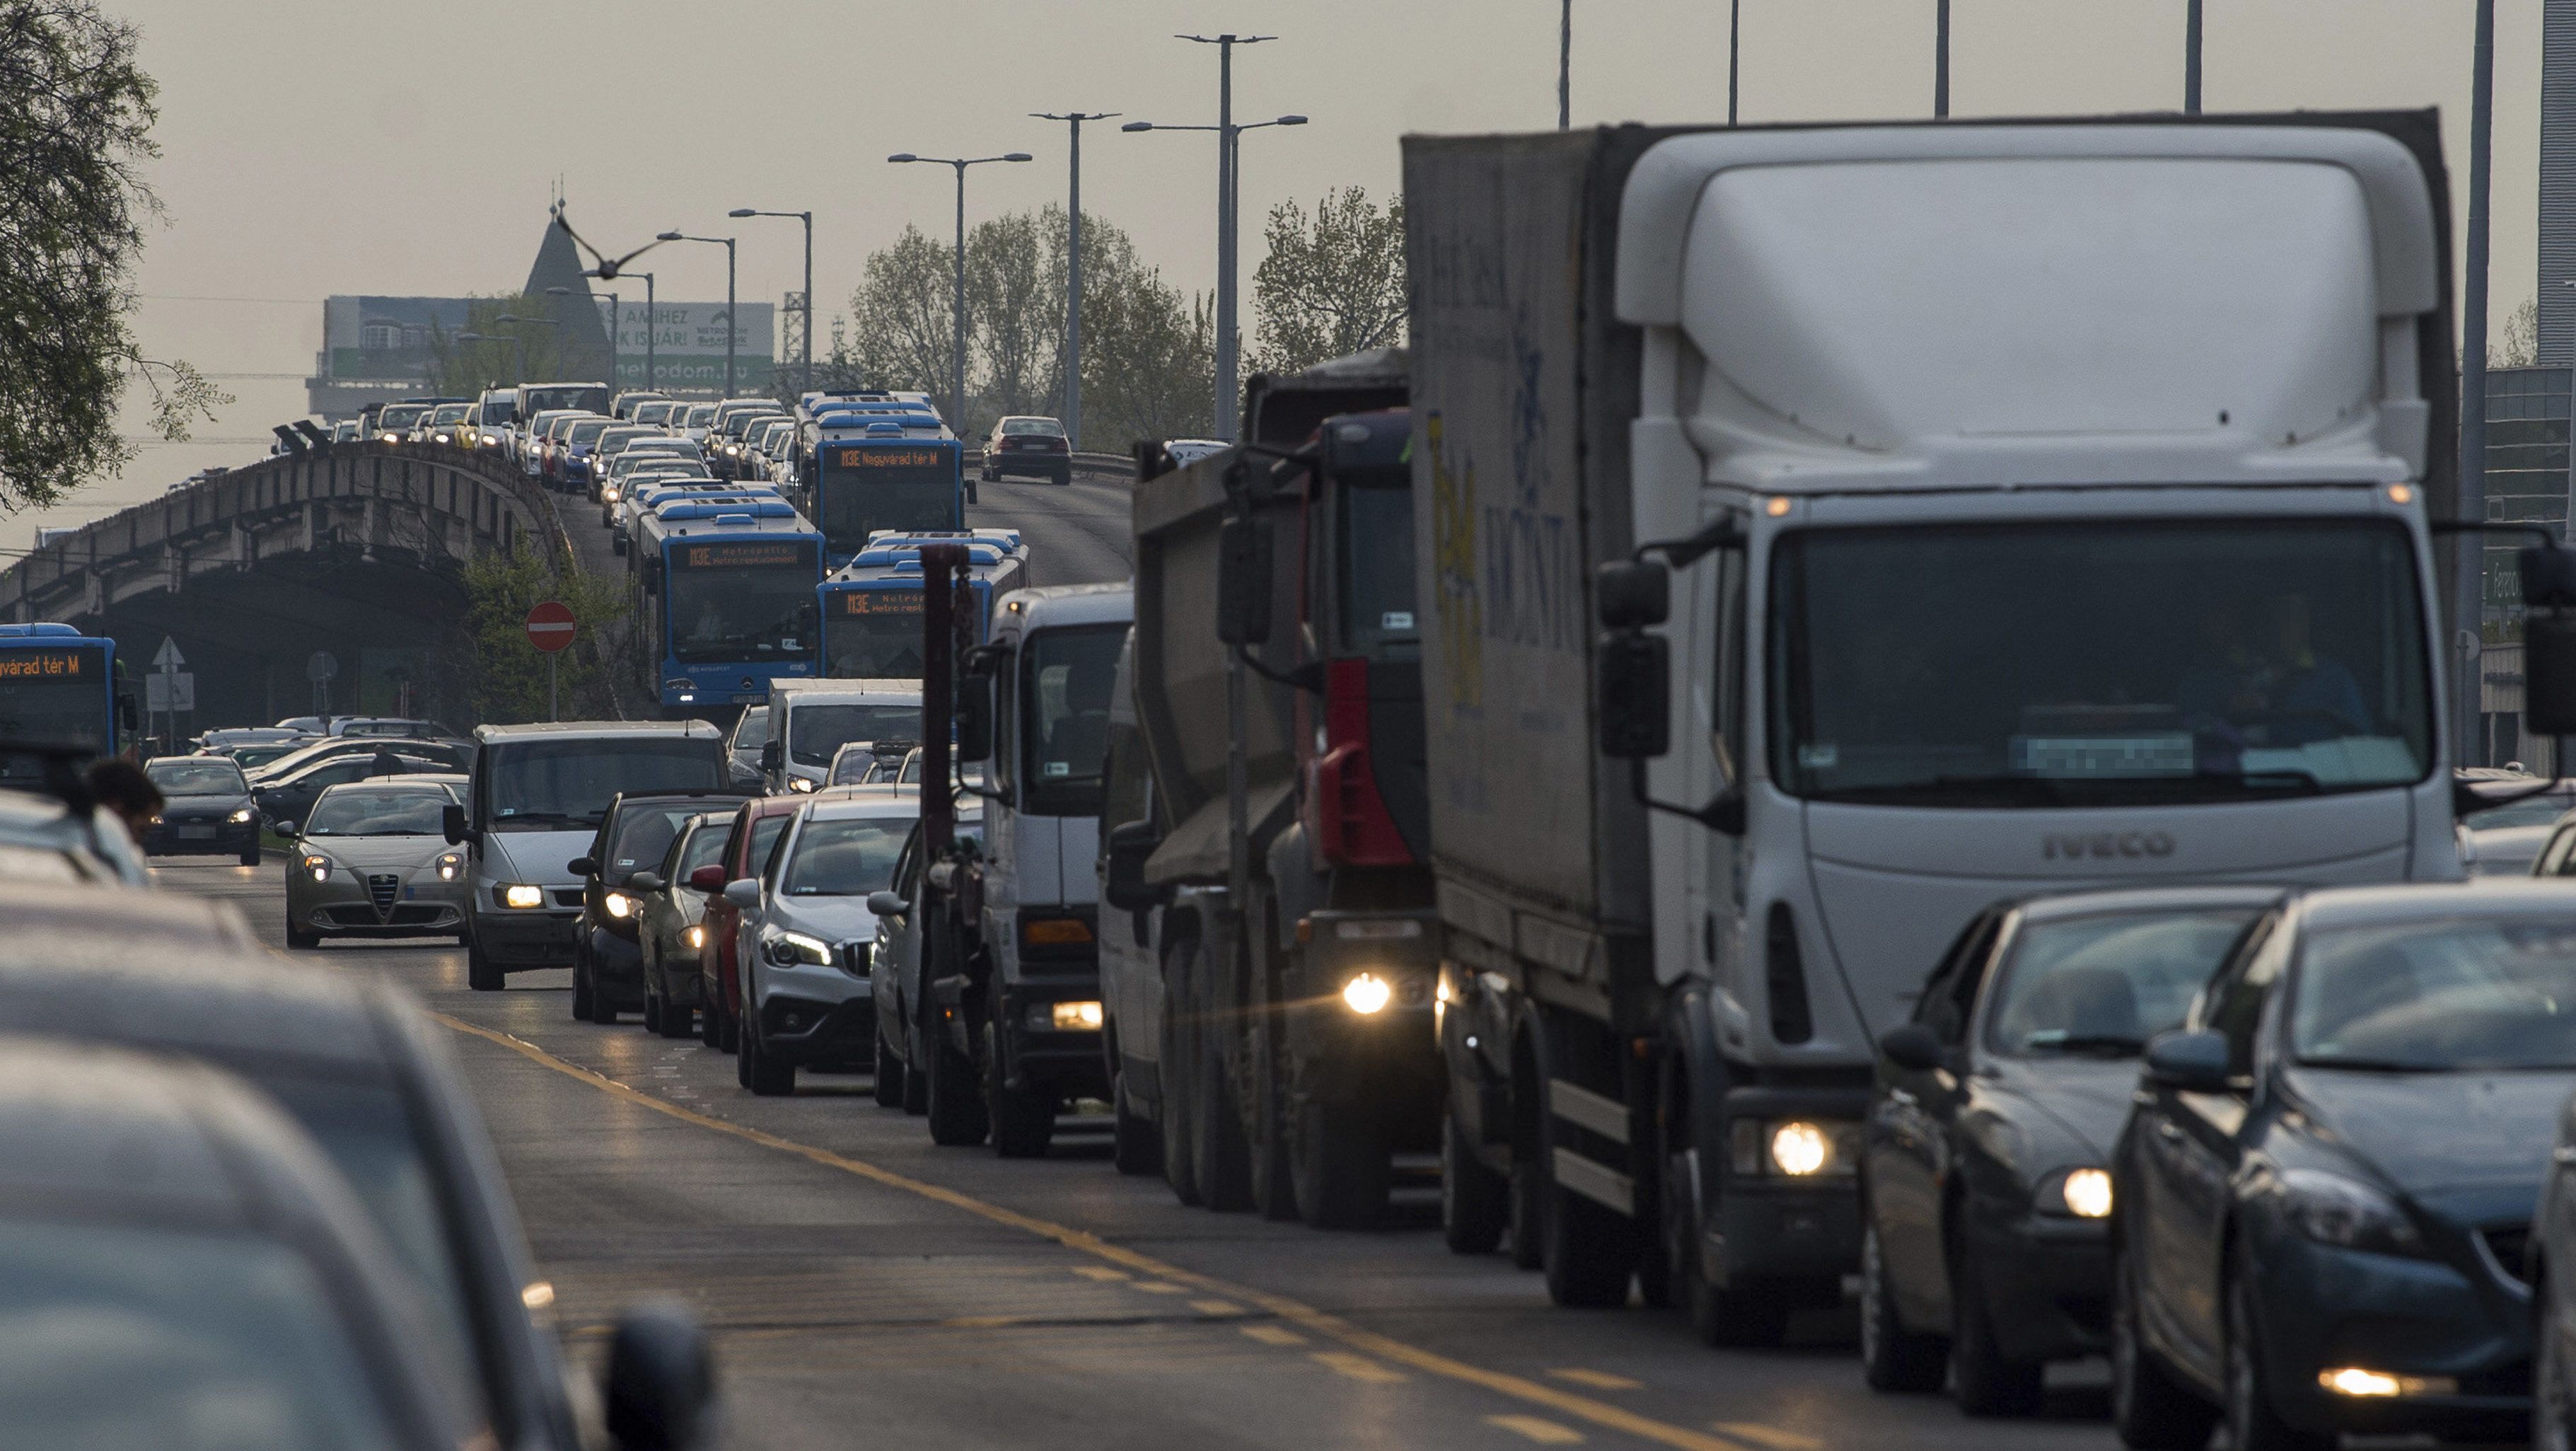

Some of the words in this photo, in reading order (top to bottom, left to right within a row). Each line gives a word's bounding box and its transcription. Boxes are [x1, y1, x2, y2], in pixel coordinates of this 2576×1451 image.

[862, 451, 911, 467] Nagyvárad
[913, 452, 928, 465] tér
[848, 594, 870, 614] M3E
[43, 655, 64, 674] tér
[68, 655, 79, 674] M
[2043, 831, 2176, 860] IVECO
